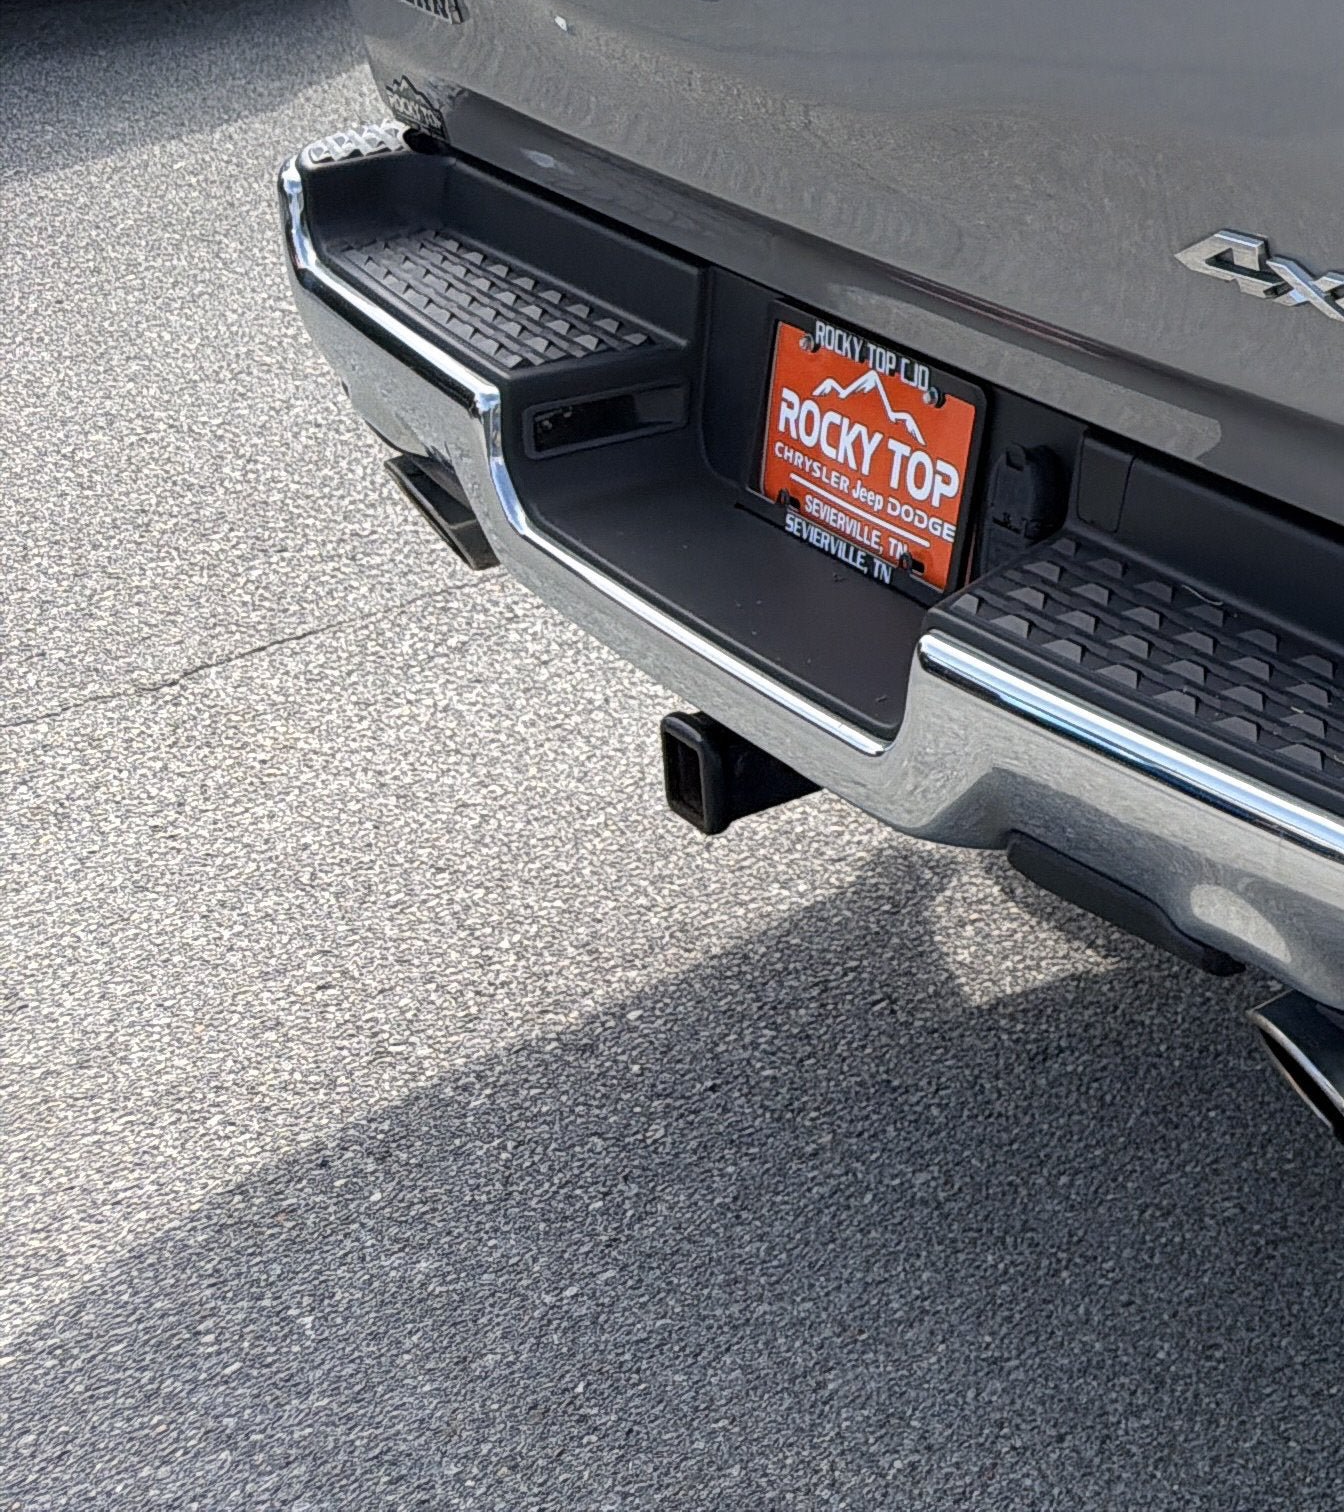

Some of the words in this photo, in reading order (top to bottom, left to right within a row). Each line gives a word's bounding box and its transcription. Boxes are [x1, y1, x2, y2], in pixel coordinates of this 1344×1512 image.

[816, 320, 863, 363] ROCKY
[867, 342, 897, 375] TOP
[901, 357, 929, 389] CJD
[778, 387, 883, 476] ROCKY
[887, 439, 960, 508] TOP
[774, 441, 850, 492] CHRYSLER
[852, 480, 884, 513] Jeep
[887, 497, 957, 543] DODGE
[784, 513, 868, 575] SEVIERVILLE,
[873, 557, 894, 584] TN
[804, 494, 884, 555] SEVIERVILLE,
[888, 536, 909, 562] TN
